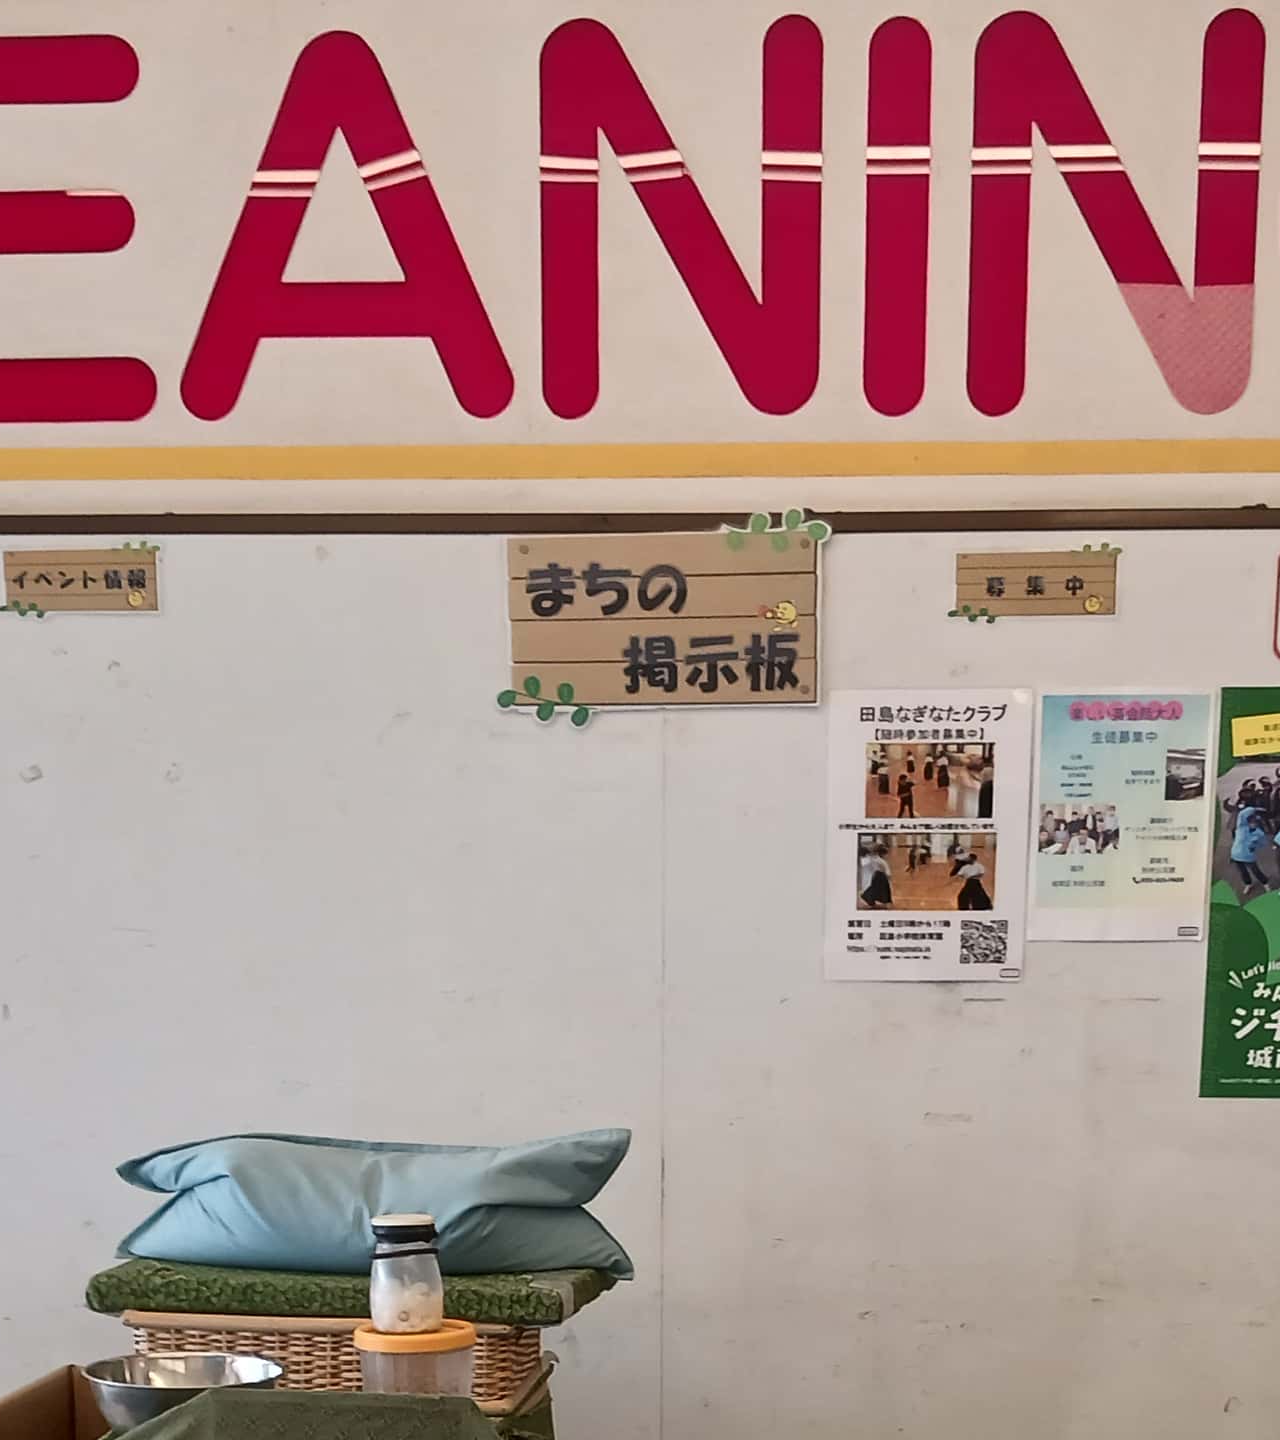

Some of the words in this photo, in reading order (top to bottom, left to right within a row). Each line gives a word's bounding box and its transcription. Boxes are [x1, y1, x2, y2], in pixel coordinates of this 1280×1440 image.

[11, 569, 147, 589] イベント情報
[525, 562, 689, 617] まちの
[985, 574, 1086, 597] 募集中
[622, 632, 801, 694] 掲示板
[859, 703, 1008, 723] 田島なぎなたクラブ
